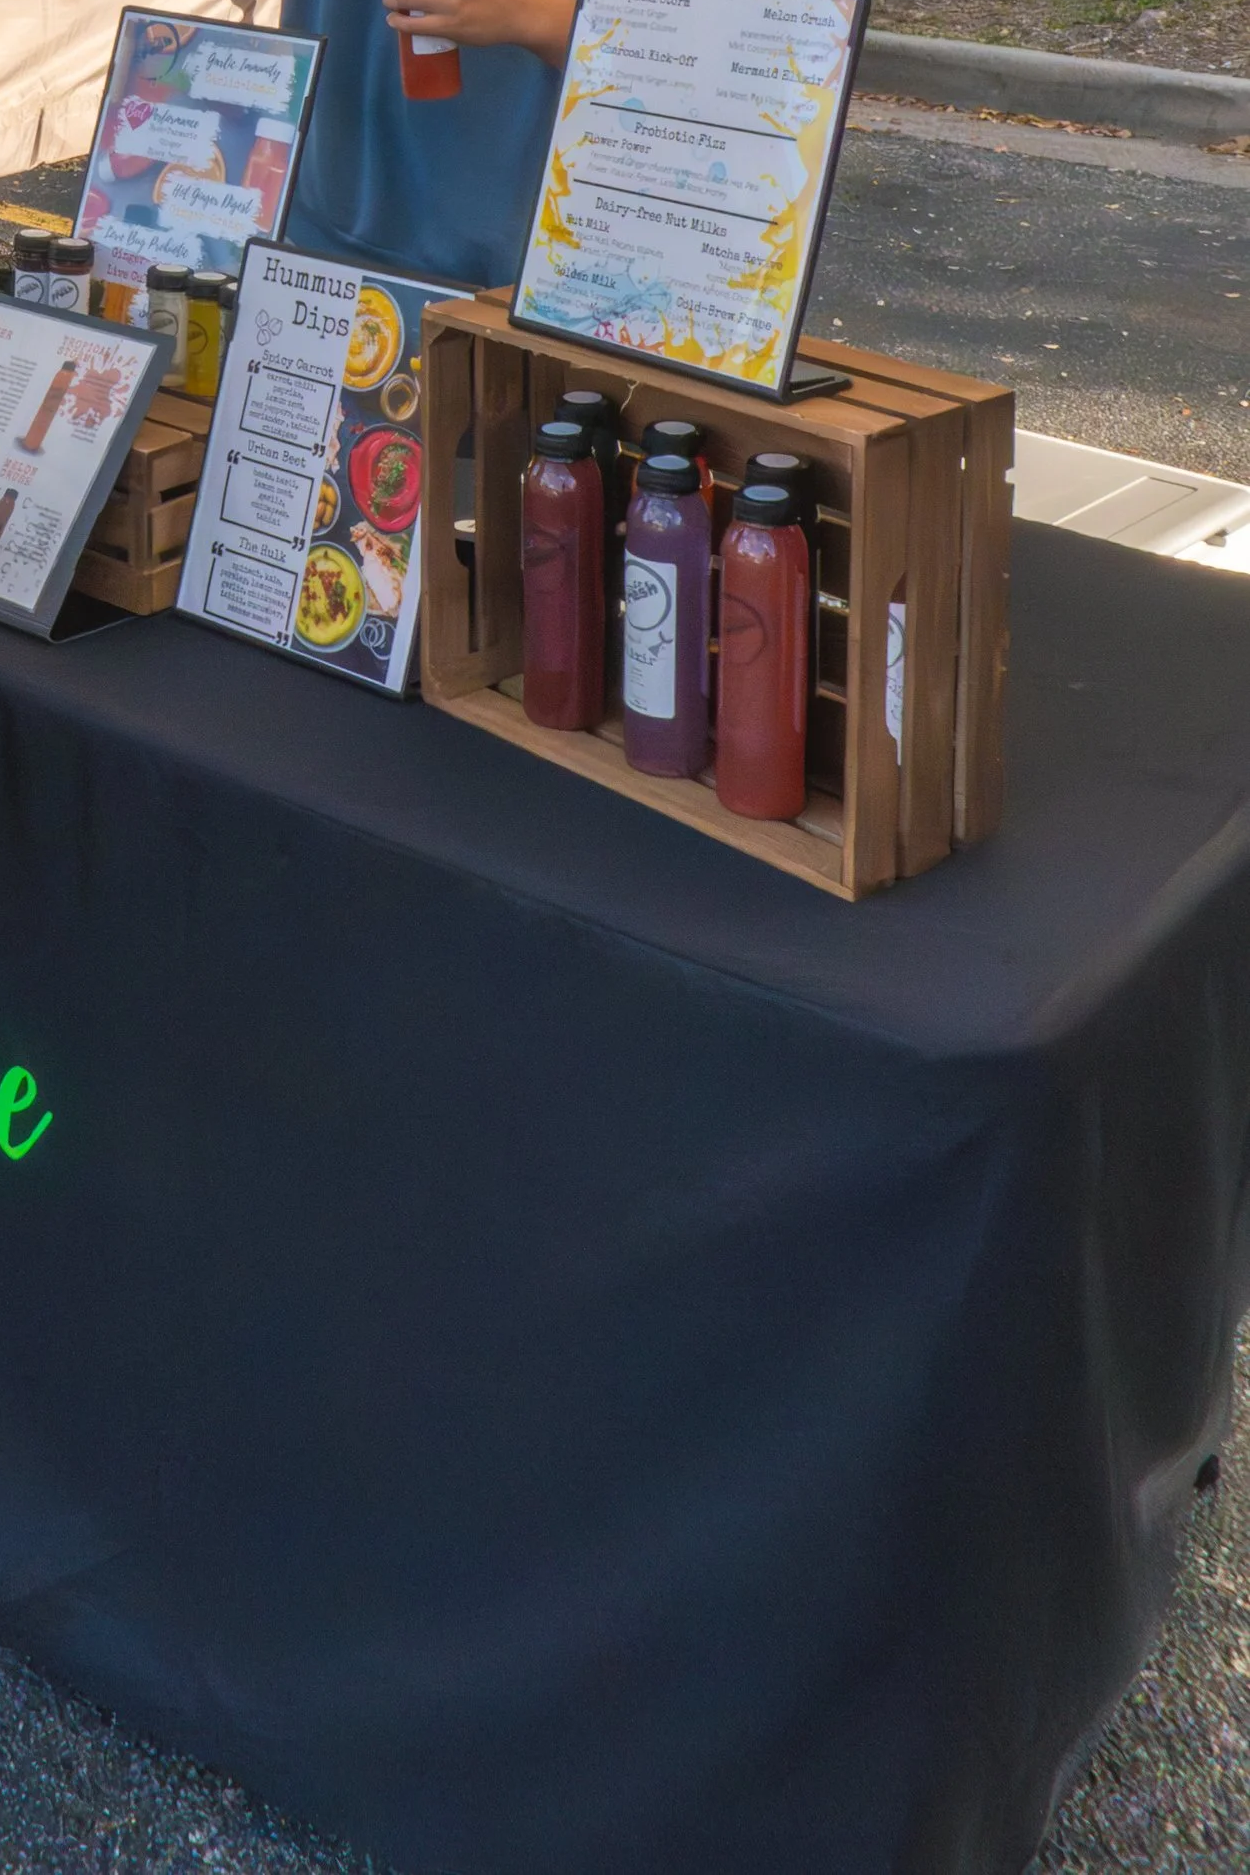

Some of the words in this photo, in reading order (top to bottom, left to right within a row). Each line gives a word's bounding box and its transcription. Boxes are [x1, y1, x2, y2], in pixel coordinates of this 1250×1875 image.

[763, 7, 797, 23] Melon
[801, 13, 835, 27] Crush
[730, 61, 779, 79] Mermaid
[620, 138, 652, 154] Power
[634, 121, 695, 145] Probiotic
[697, 133, 726, 150] Fizz
[586, 218, 611, 233] Milk
[595, 197, 662, 223] Dairy-free
[665, 212, 688, 228] Nut
[690, 218, 727, 237] Milks
[702, 242, 740, 261] Matcha
[263, 257, 356, 300] Hummus
[591, 273, 617, 289] Milk
[292, 300, 350, 339] Dips
[676, 296, 736, 321] Cold-Brew
[262, 349, 293, 369] Spicy
[296, 358, 334, 378] Carrot
[247, 439, 279, 460] Urban
[282, 449, 306, 468] Beet
[239, 536, 258, 552] The
[260, 544, 287, 563] Hulk
